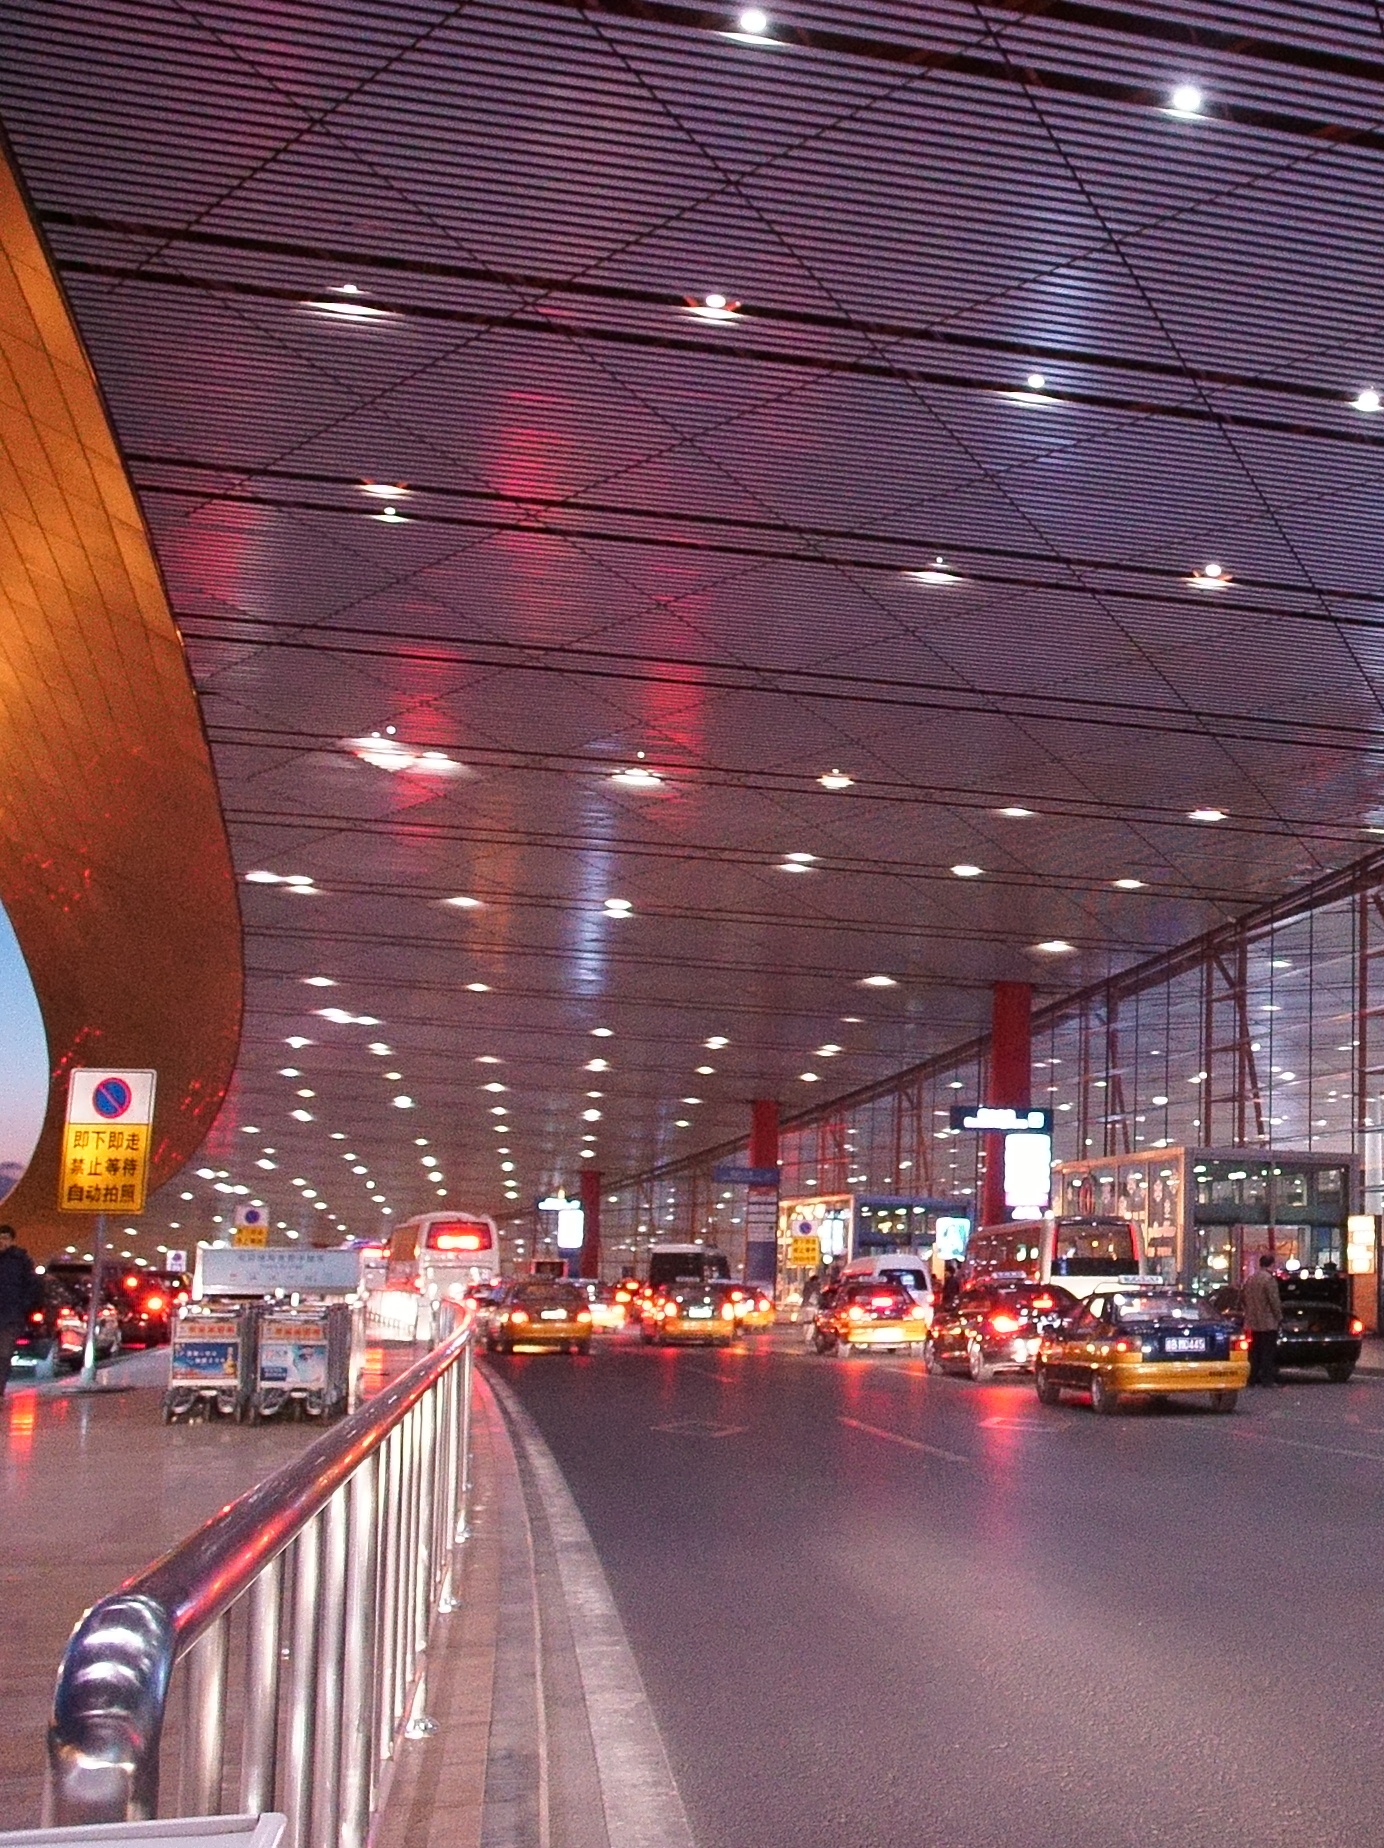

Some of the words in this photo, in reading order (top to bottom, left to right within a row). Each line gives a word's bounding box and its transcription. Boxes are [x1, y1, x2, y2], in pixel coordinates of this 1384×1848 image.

[73, 1130, 140, 1151] 即下即走
[70, 1157, 138, 1177] 禁止等待
[67, 1184, 136, 1203] 自动拍照
